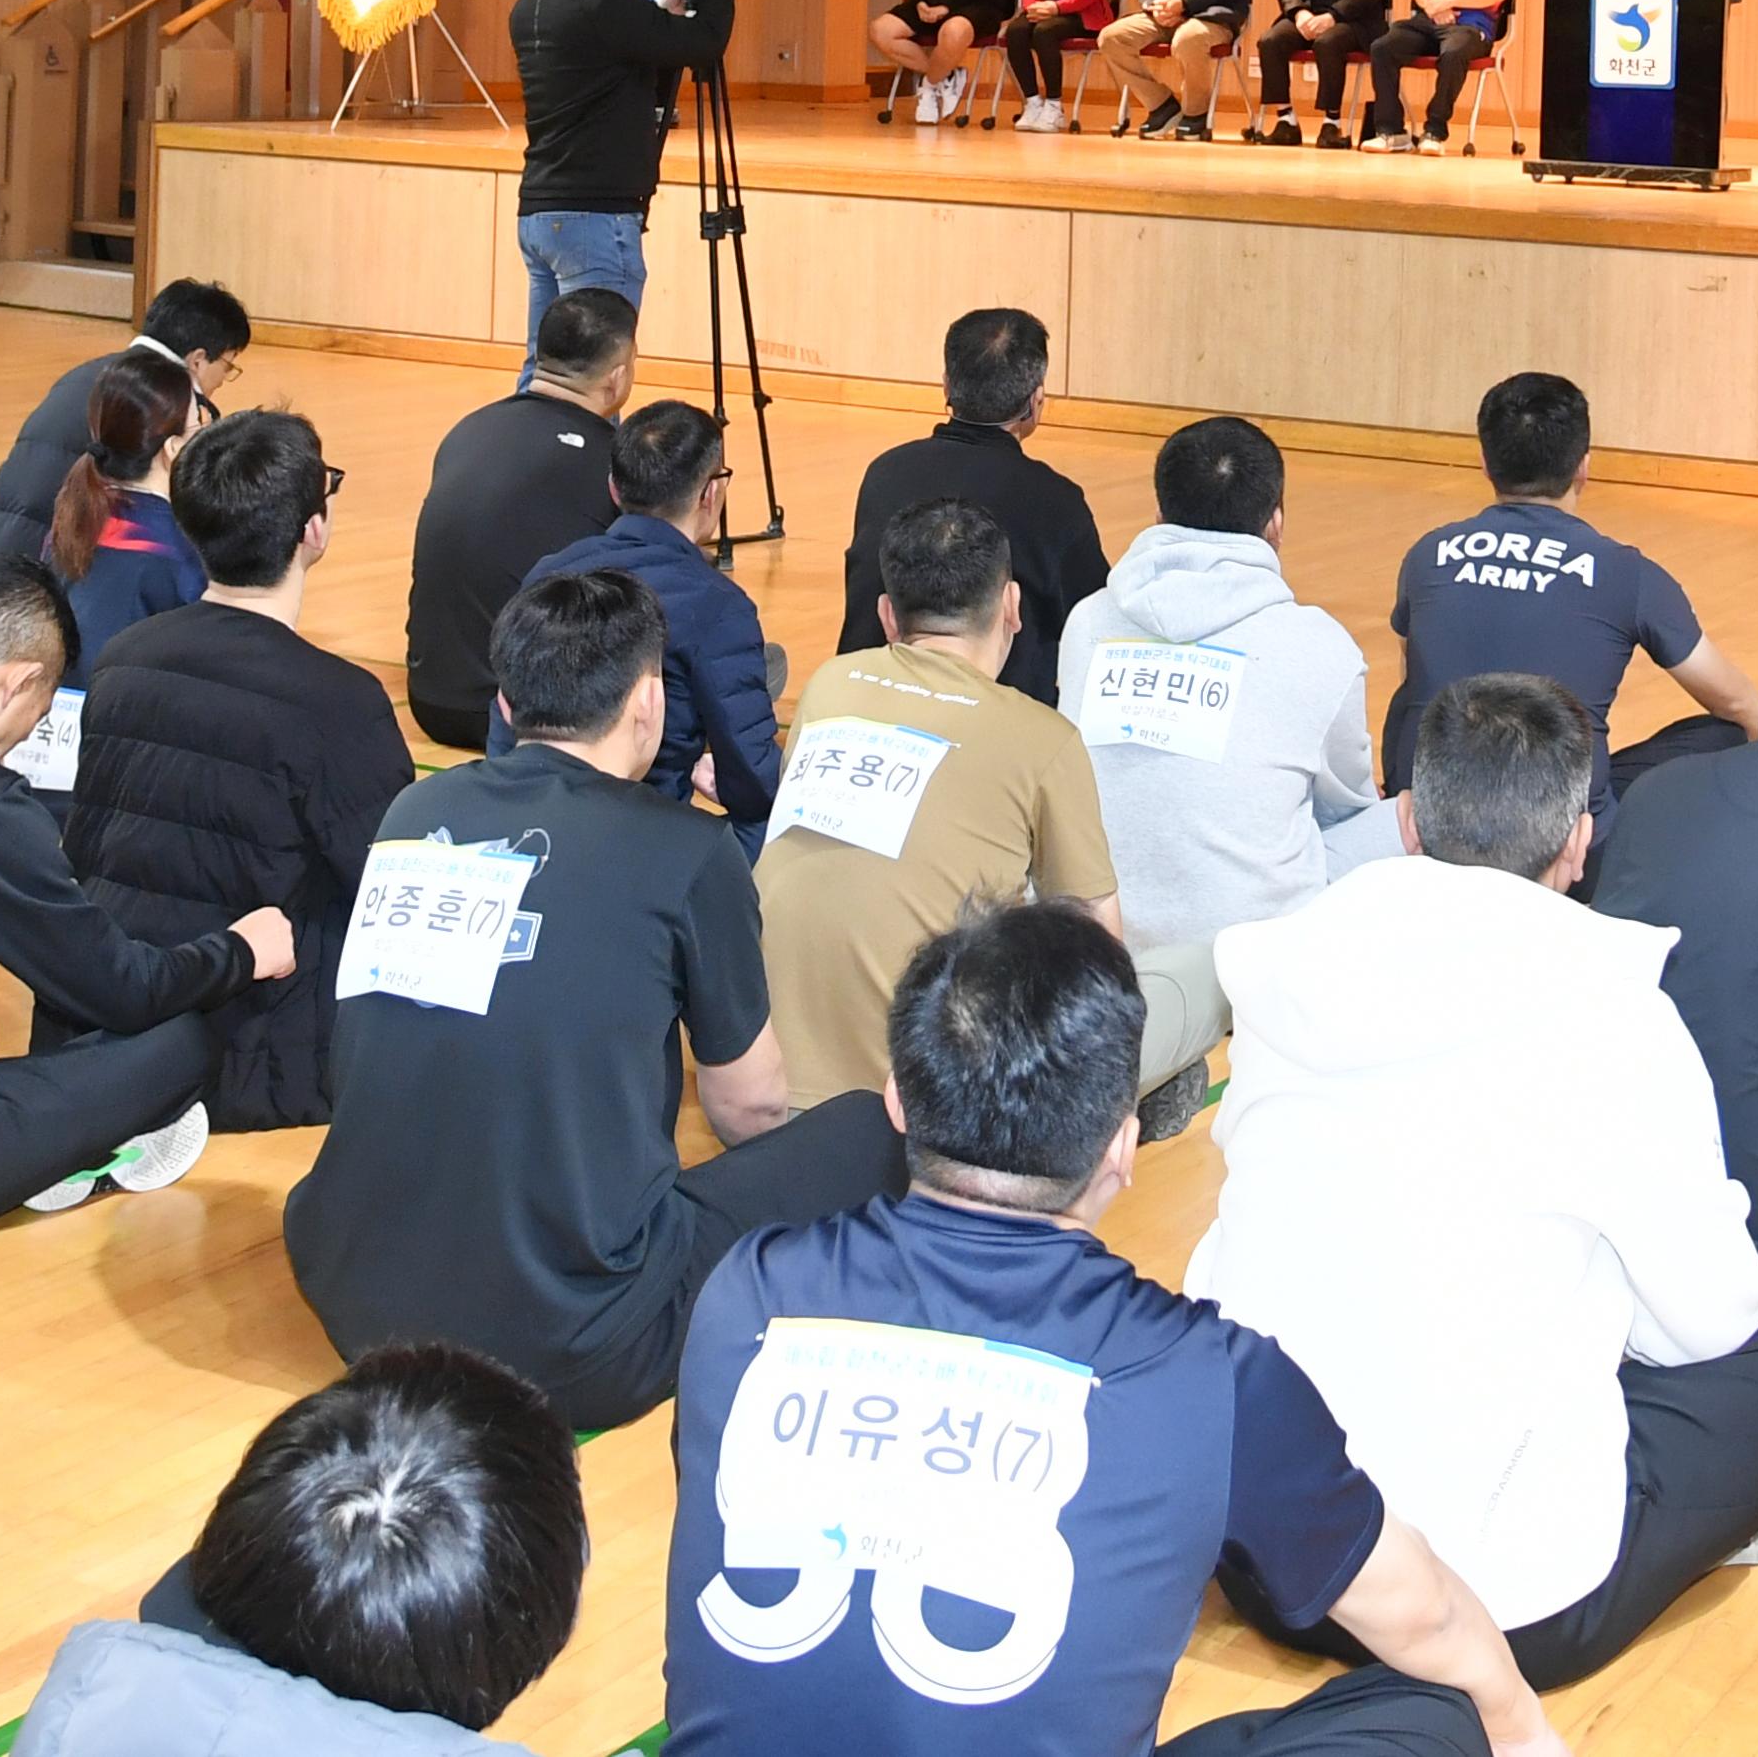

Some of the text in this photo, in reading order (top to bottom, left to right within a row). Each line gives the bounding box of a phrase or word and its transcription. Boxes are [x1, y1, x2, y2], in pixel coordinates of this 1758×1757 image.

[1609, 58, 1656, 76] 화천군
[1437, 531, 1595, 587] KOREA
[1454, 562, 1557, 593] ARMY
[1100, 667, 1230, 711] 신현민(6)
[361, 884, 506, 939] 안종훈(7)
[772, 1389, 1054, 1493] 이유성(7)
